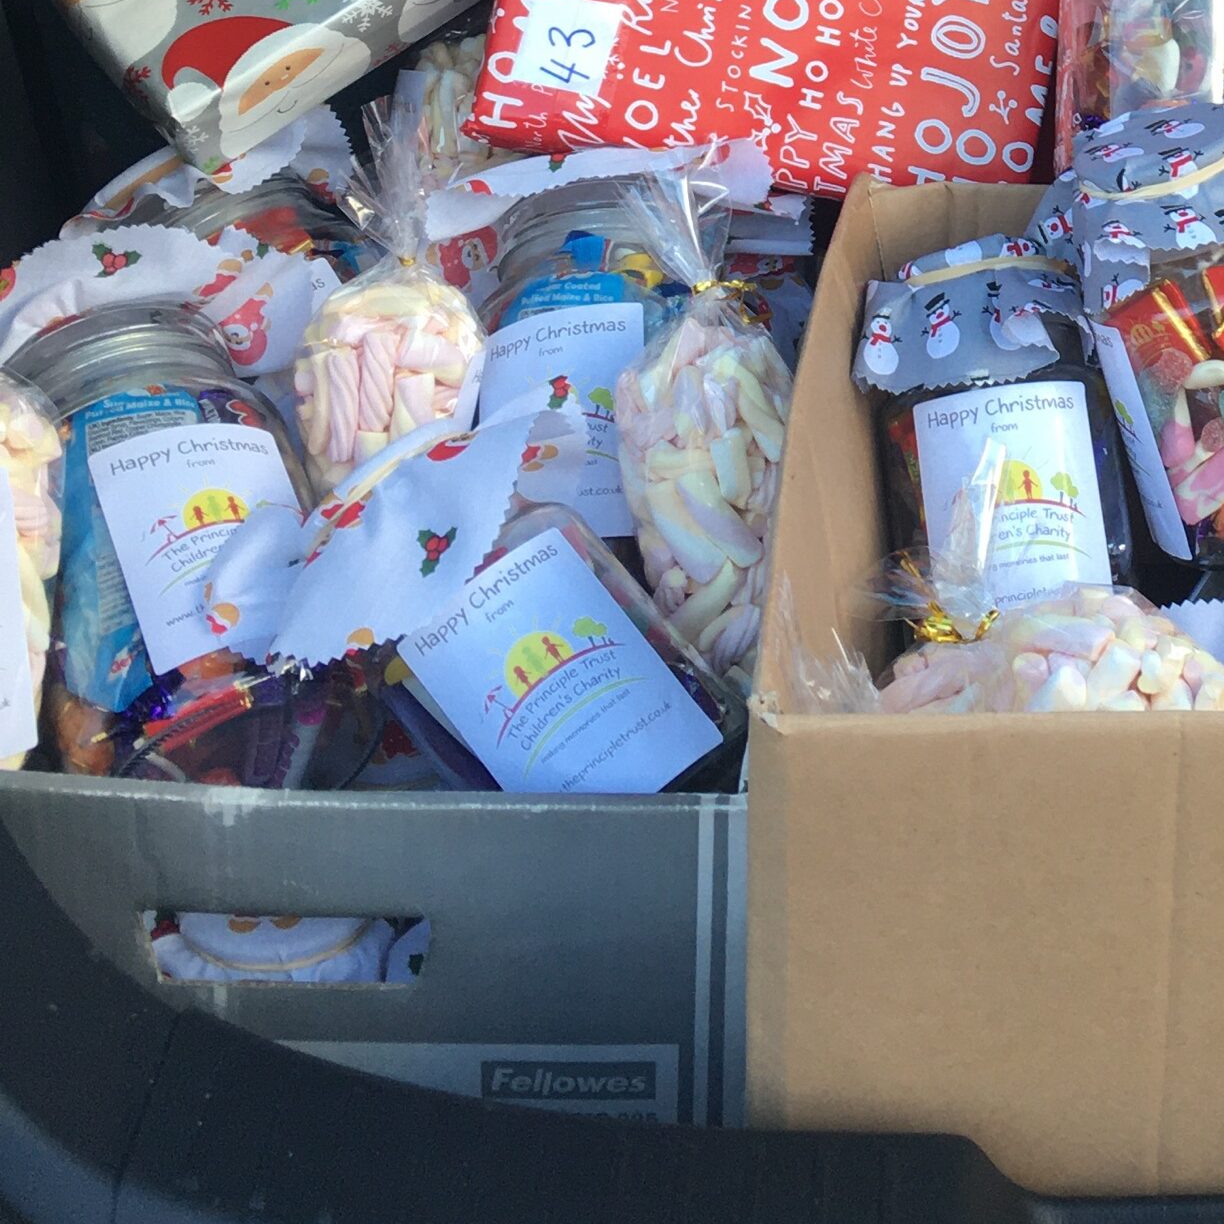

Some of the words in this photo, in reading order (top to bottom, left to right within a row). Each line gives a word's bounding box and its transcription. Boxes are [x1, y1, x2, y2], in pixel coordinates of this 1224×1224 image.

[539, 26, 597, 85] 43
[849, 23, 878, 92] White
[799, 60, 830, 111] HO
[867, 102, 907, 185] HANG
[889, 62, 914, 87] UP
[489, 334, 532, 362] Happy
[535, 319, 627, 343] Christmas
[538, 345, 564, 358] from
[927, 406, 980, 430] Happy
[984, 394, 1075, 417] Christmas
[991, 421, 1020, 433] from
[109, 446, 171, 477] Happy
[177, 437, 270, 457] Christmas
[185, 457, 217, 470] from
[1025, 523, 1073, 542] Charity
[1042, 507, 1075, 524] Trust
[160, 541, 190, 562] The
[413, 607, 471, 658] Happy
[467, 543, 560, 611] Christmas
[484, 598, 516, 625] from
[505, 714, 531, 742] The
[524, 666, 580, 717] Principle
[579, 648, 619, 672] Trust
[520, 693, 575, 753] Children's
[572, 665, 626, 702] Charity
[490, 1066, 648, 1096] Fellowes
